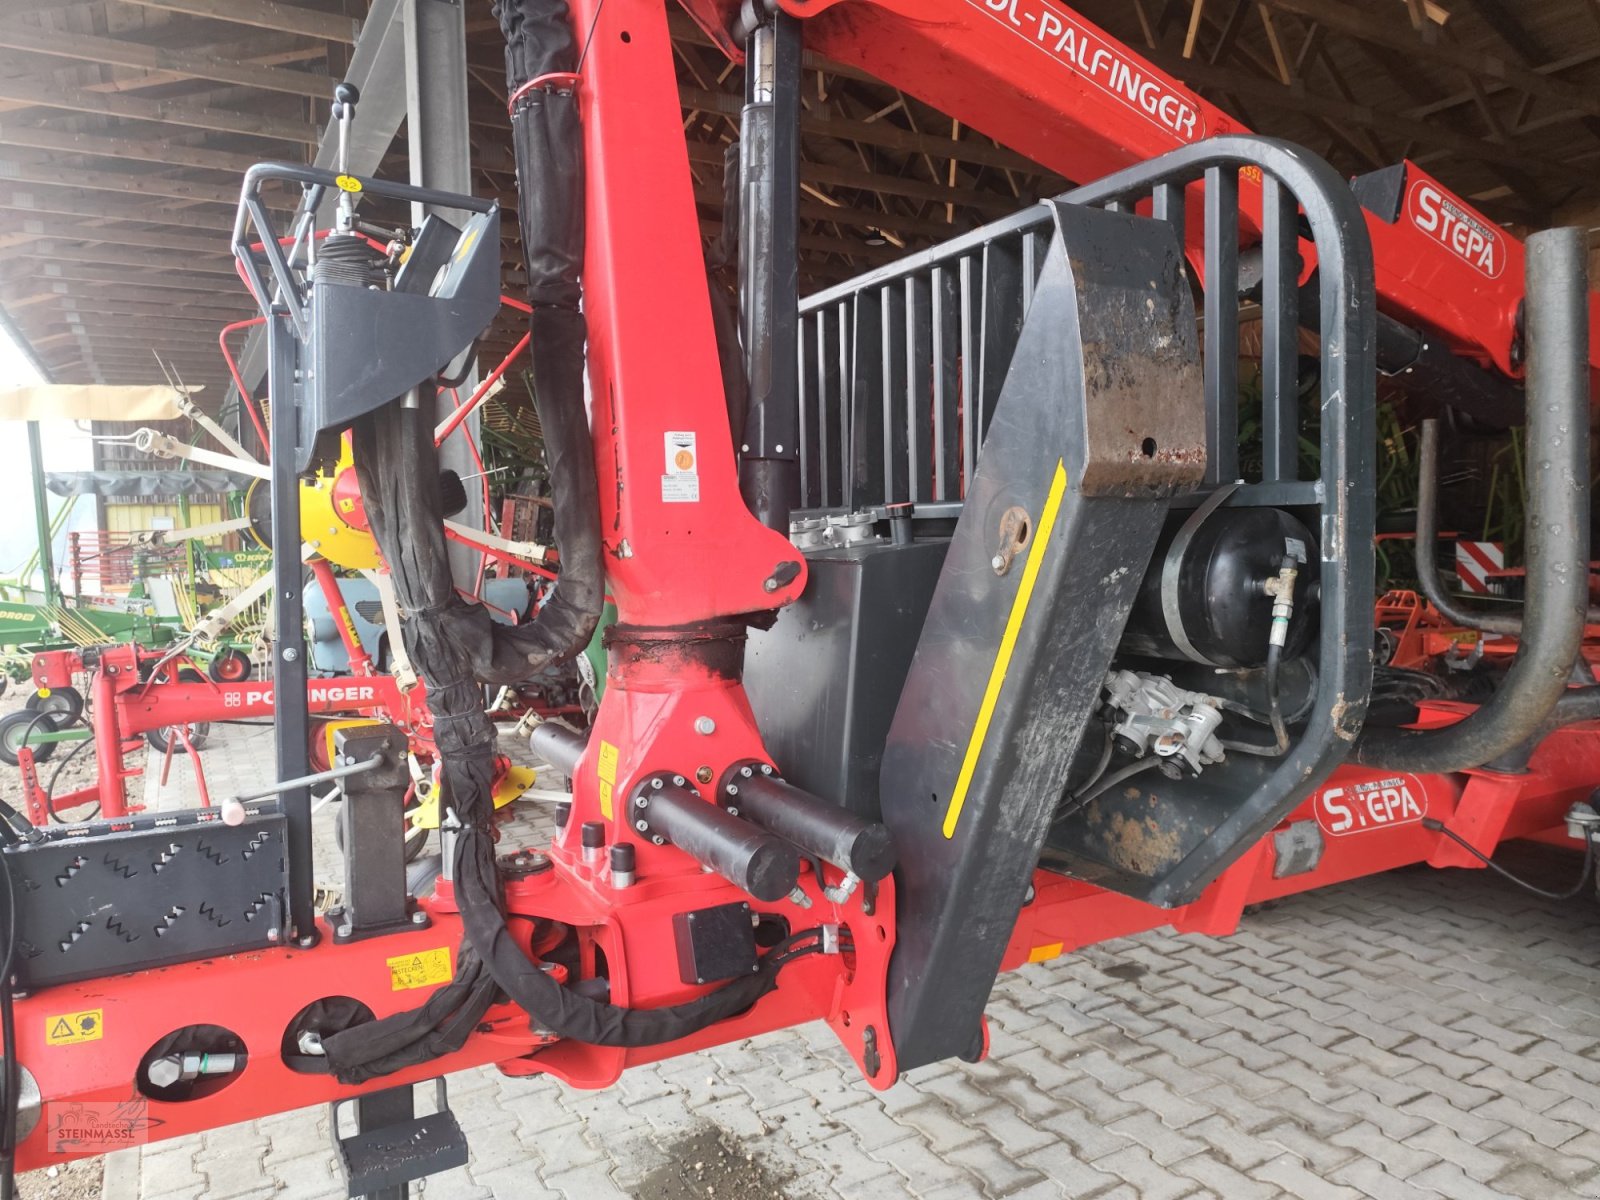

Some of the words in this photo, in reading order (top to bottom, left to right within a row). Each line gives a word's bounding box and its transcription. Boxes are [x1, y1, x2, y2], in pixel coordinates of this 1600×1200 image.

[341, 180, 356, 190] 32
[1416, 186, 1493, 275] STEPA
[246, 686, 374, 706] PONGER
